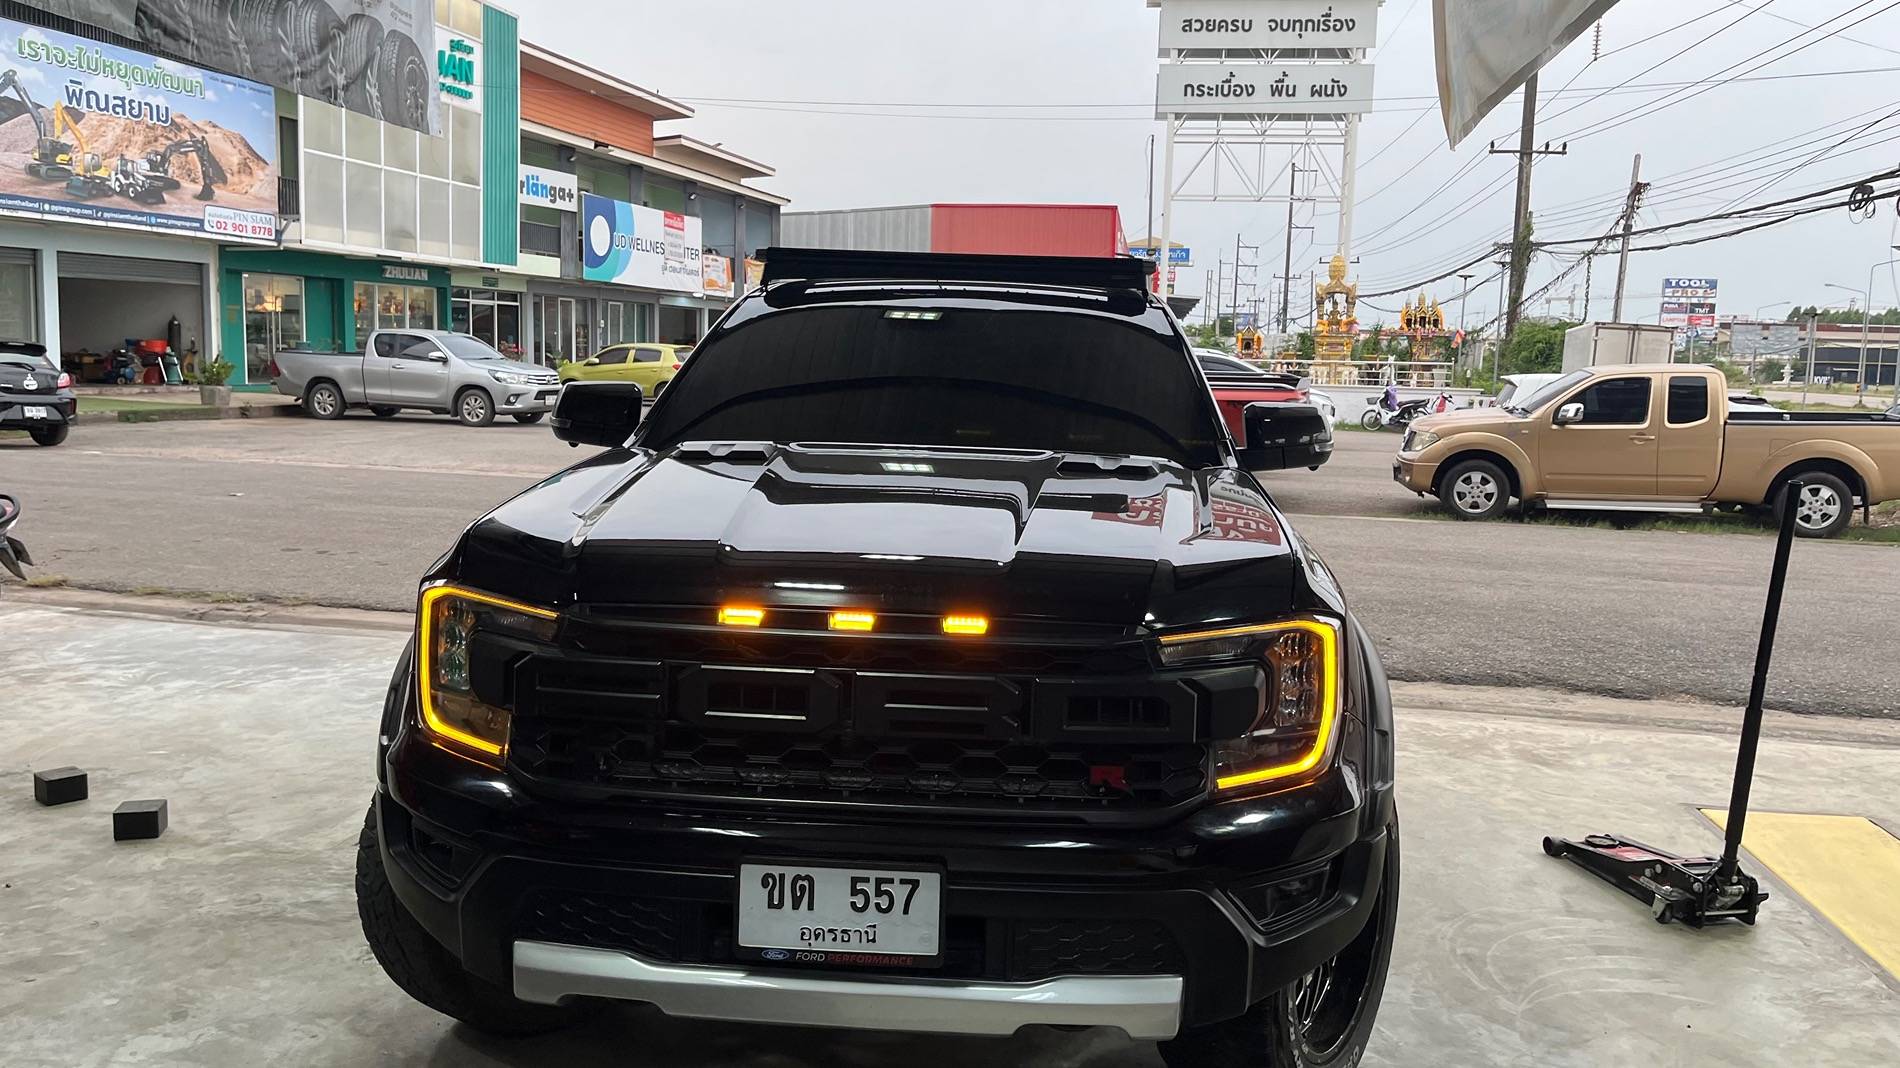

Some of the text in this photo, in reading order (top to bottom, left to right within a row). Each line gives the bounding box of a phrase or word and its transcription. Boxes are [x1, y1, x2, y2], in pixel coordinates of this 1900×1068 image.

[1181, 6, 1356, 39] สวยครบ จบทุกเรื่อง
[17, 36, 206, 99] เราจะไม่หยุดพัฒนา
[1183, 71, 1348, 98] กระเบื้อง พื้น ผนัง
[65, 78, 172, 125] พิณสยาม
[215, 220, 273, 237] 02 901 8778
[233, 211, 249, 223] PIN
[251, 214, 272, 226] SIAM
[613, 234, 627, 249] UD
[628, 236, 665, 255] WELLNES
[383, 265, 428, 280] ZHULIAN
[1669, 279, 1710, 288] TOOL
[761, 873, 921, 915] ขต 557
[800, 924, 877, 947] อุดรธานี
[796, 952, 913, 966] FORD PERFORMANCE
